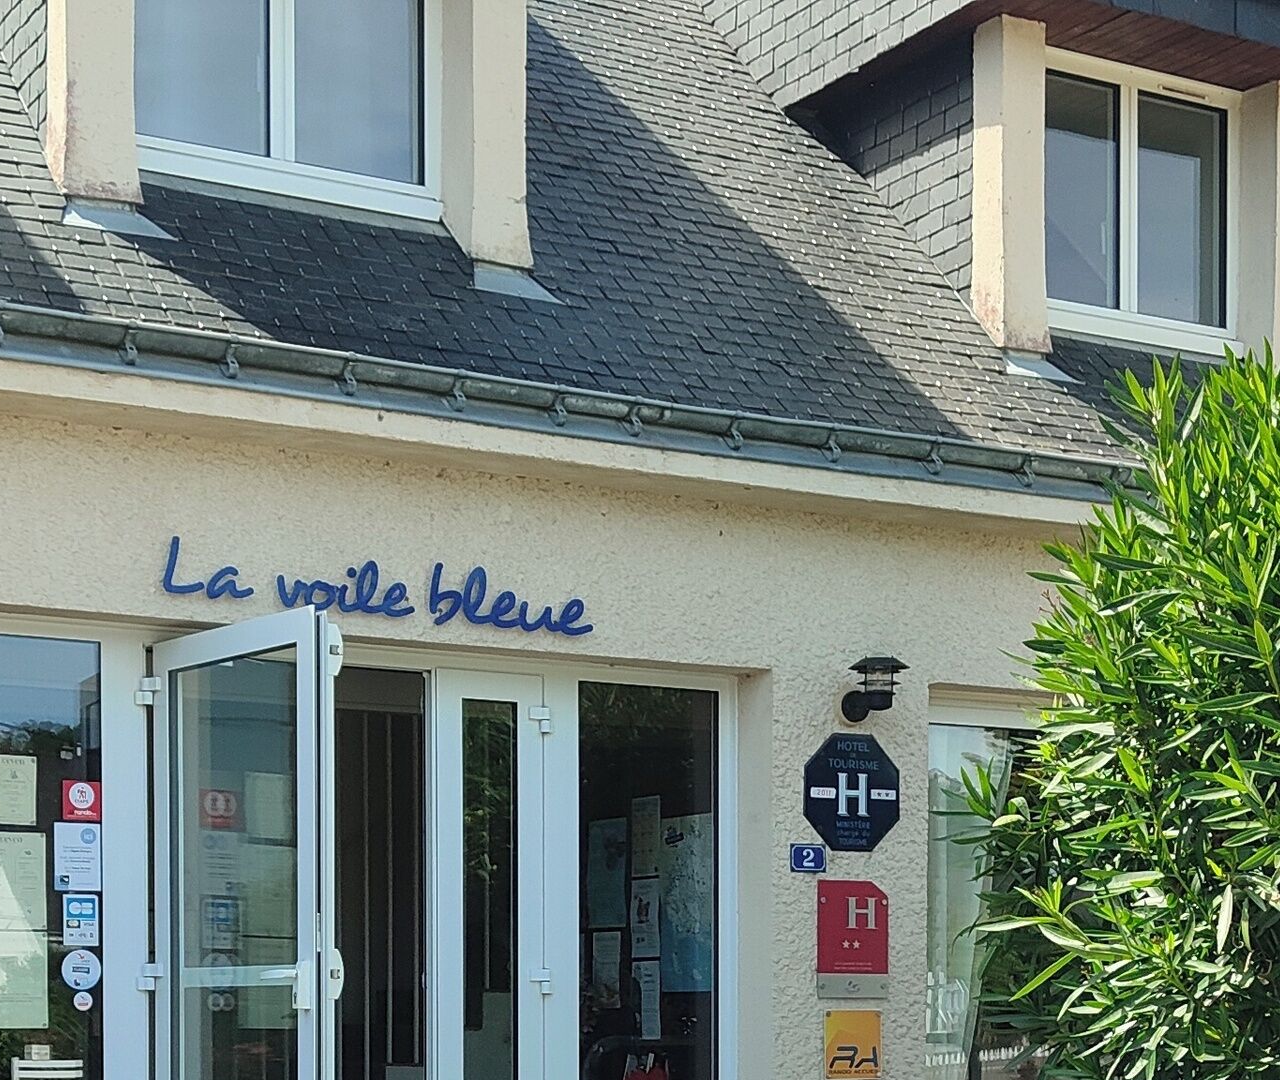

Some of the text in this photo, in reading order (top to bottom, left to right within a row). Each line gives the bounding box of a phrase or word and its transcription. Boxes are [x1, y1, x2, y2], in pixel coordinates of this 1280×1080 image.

[162, 535, 594, 635] La voile bleue
[828, 758, 880, 770] TOURISME
[837, 772, 870, 817] H
[802, 848, 815, 867] 2
[845, 896, 879, 930] H
